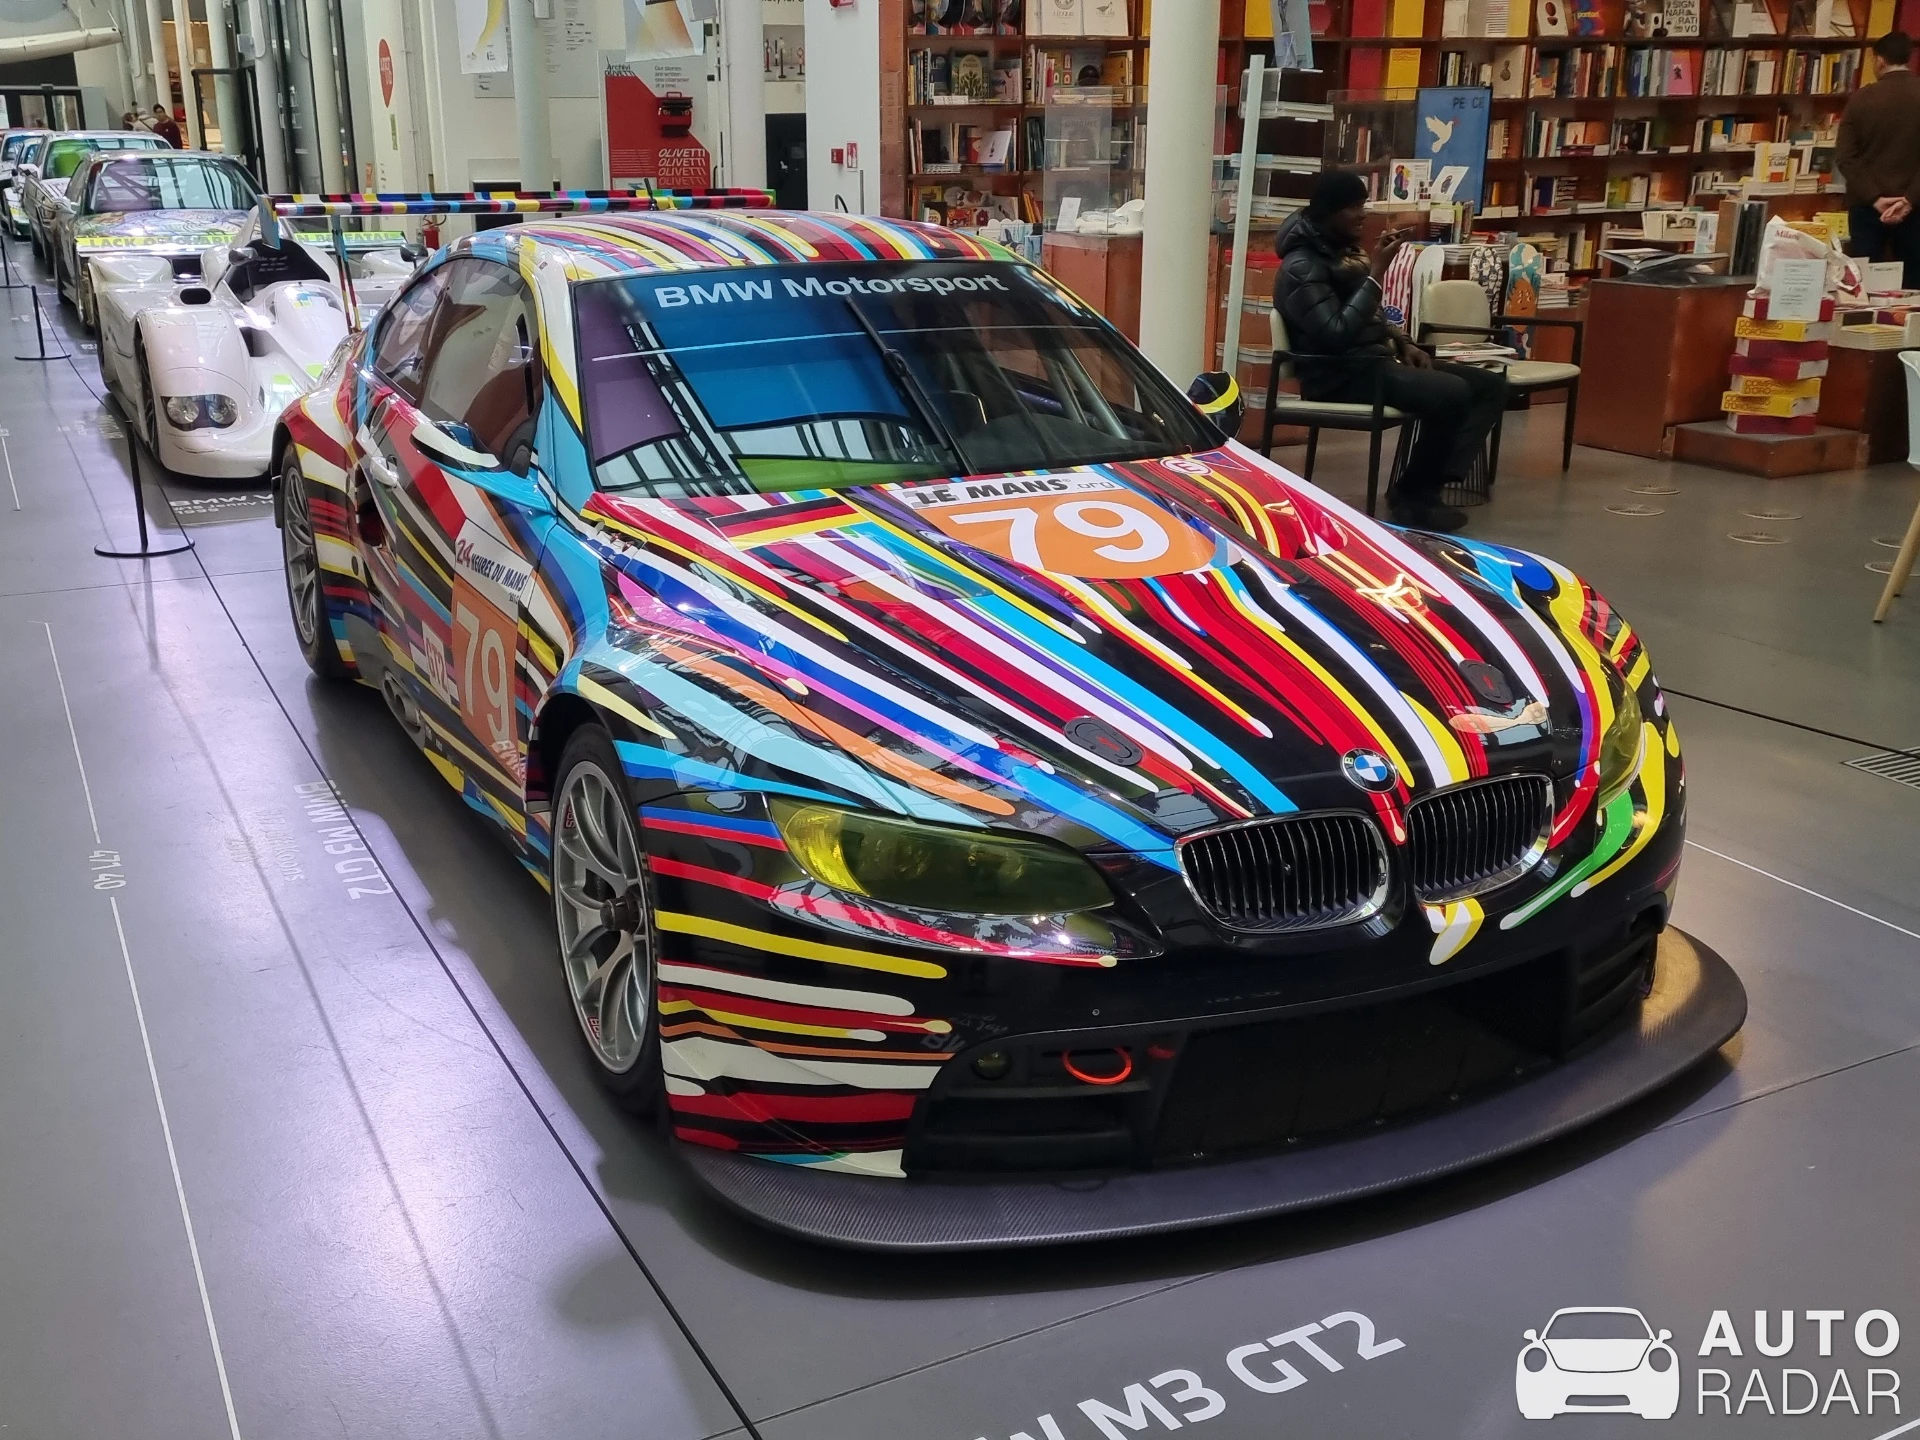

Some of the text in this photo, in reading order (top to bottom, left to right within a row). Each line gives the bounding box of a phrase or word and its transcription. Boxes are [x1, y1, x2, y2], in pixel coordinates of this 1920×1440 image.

[658, 148, 706, 158] OLIVETTI
[658, 158, 706, 167] OLIVETTI
[658, 167, 707, 176] OLIVETTI
[89, 237, 137, 248] LACK
[653, 273, 1010, 309] BMW Motorsport
[915, 489, 957, 505] LE
[947, 500, 1170, 571] 79
[456, 538, 528, 592] 24 HEURES DU MANS
[455, 600, 510, 742] 79
[293, 779, 395, 900] BMW M3 GT2
[1077, 1311, 1406, 1440] M3 GT2
